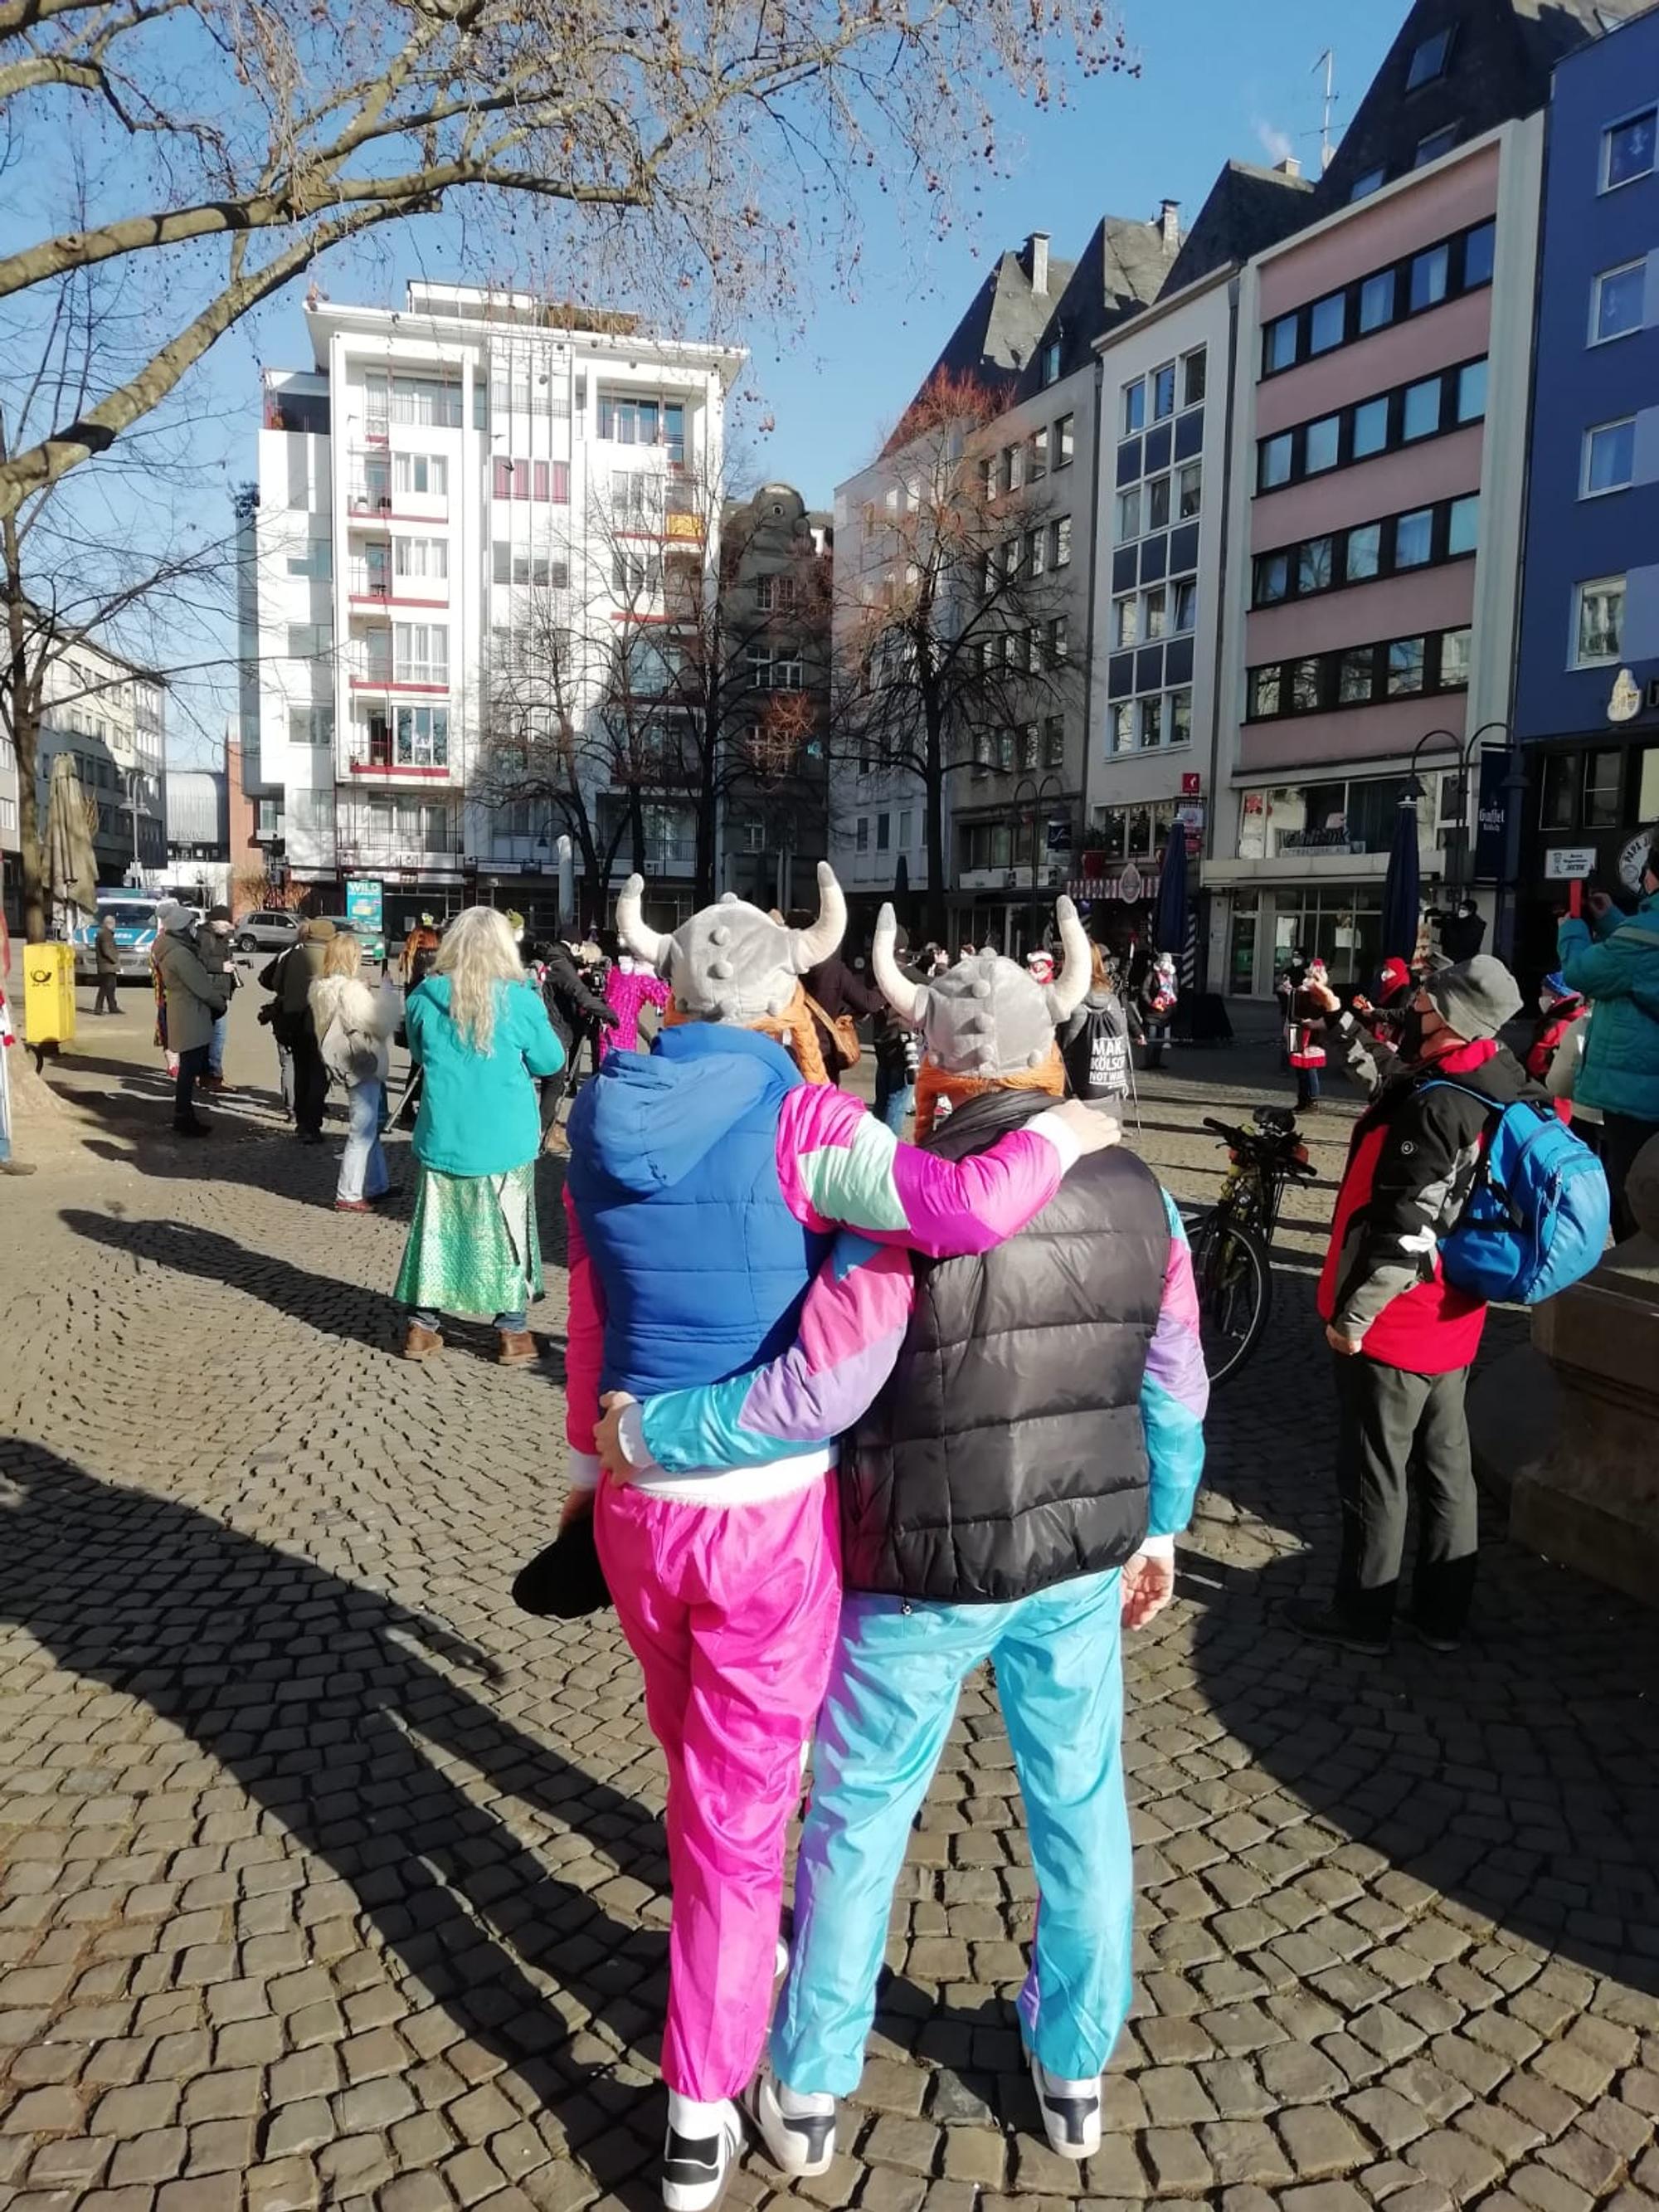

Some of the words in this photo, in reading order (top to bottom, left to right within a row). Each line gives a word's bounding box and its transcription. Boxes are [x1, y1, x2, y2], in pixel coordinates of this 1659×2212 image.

[1624, 841, 1642, 863] PAPA
[1090, 1055, 1125, 1071] KÖLSC
[1089, 1070, 1108, 1082] NOT
